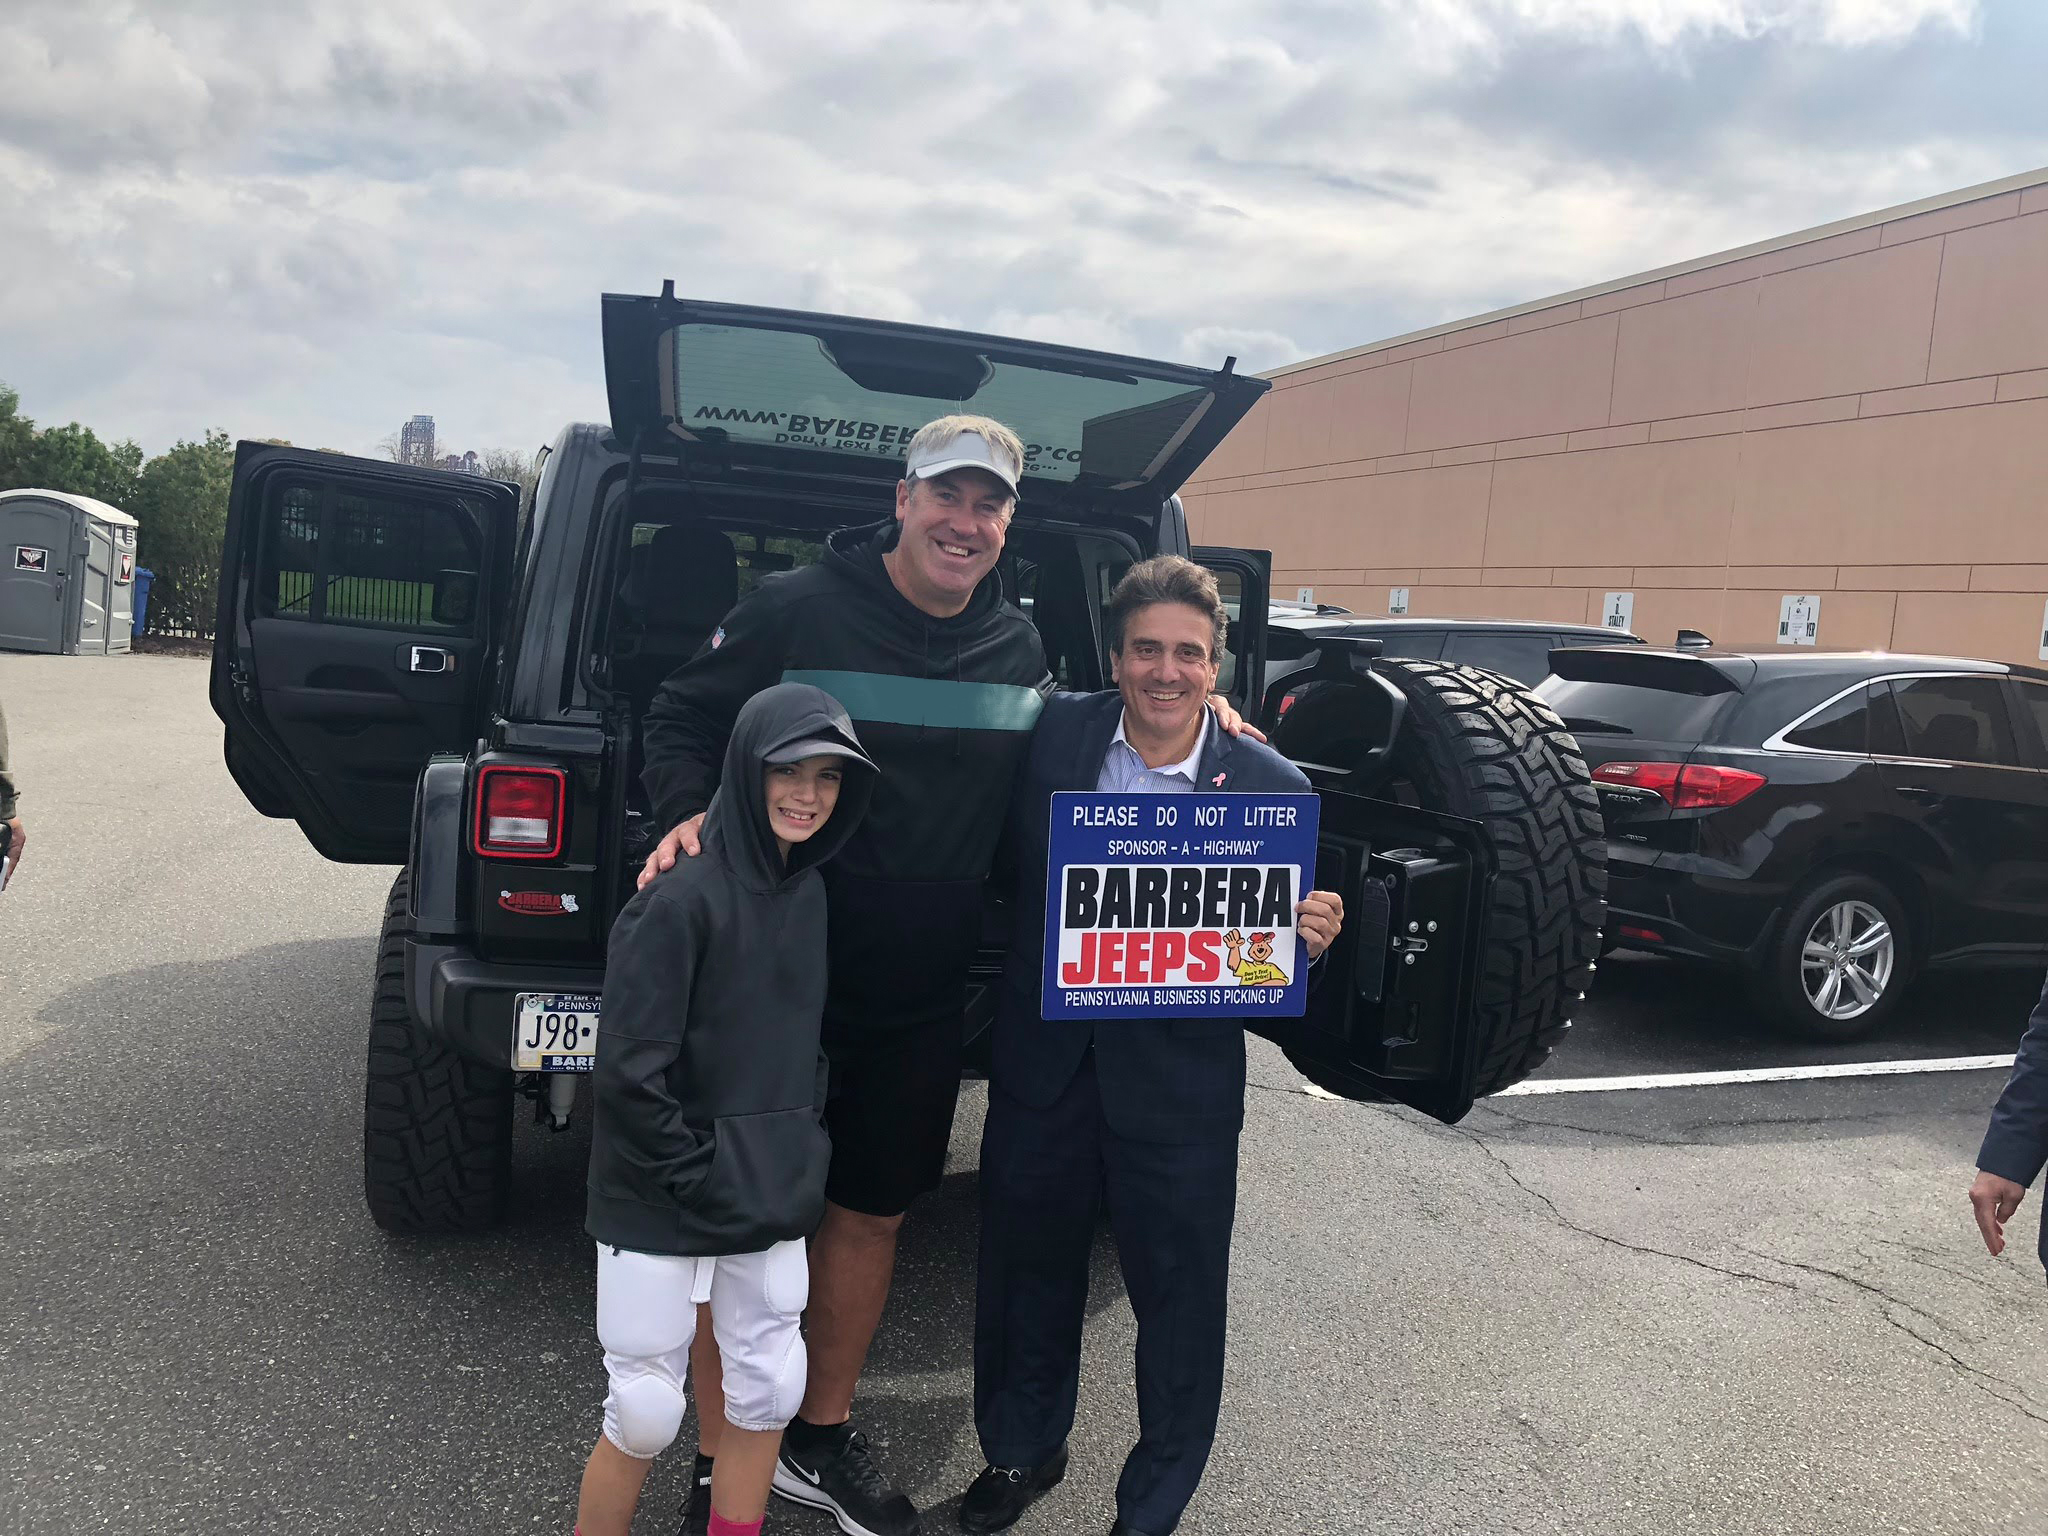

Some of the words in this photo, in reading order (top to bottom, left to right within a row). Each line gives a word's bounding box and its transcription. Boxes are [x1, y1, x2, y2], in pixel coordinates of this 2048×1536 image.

[1605, 793, 1643, 805] RDX
[1072, 806, 1138, 827] PLEASE
[1156, 806, 1177, 826] DO
[1194, 806, 1227, 827] NOT
[1244, 806, 1297, 827] LITTER
[1107, 840, 1167, 856] SPONSOR
[1181, 841, 1190, 856] A
[1064, 867, 1292, 928] BARBERA
[1062, 930, 1221, 985] JEEPS
[1065, 990, 1150, 1006] PENNSYLVANIA
[1154, 989, 1206, 1005] BUSINESS
[1210, 989, 1220, 1004] IS
[1224, 989, 1266, 1004] PICKING
[1269, 988, 1284, 1004] UP
